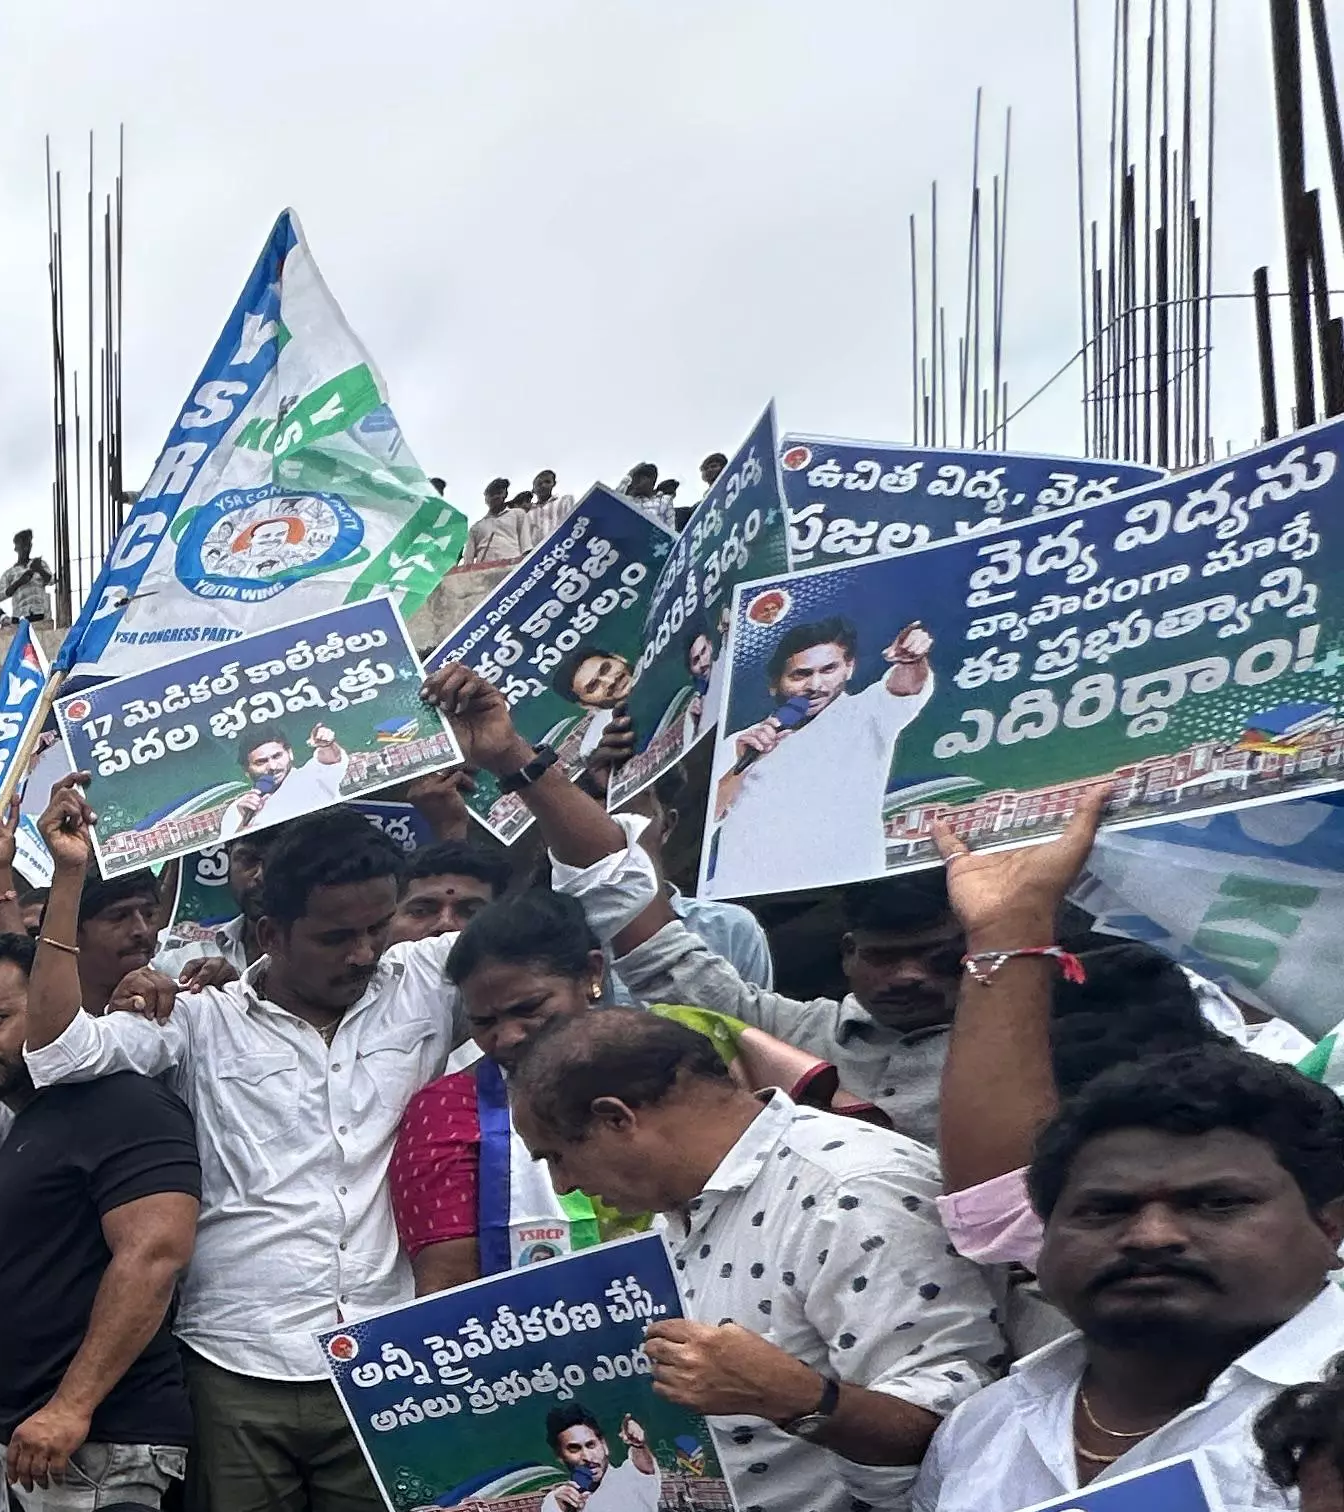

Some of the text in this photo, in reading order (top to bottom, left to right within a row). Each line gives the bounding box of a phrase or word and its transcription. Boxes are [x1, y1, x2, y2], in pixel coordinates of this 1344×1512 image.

[808, 459, 923, 493] ఉచిత
[966, 443, 1338, 609] వైద్య విద్యను
[519, 536, 619, 640] కాలేజీ
[528, 562, 648, 675] సంకల్పం
[953, 565, 1321, 692] ఈ ప్రభుత్వాన్ని
[966, 511, 1323, 645] వ్యాపారంగా మార్చే
[83, 629, 390, 741] 17 మెడికల్ కాలేజీలు
[115, 626, 244, 645] YSR CONGRESS PARTY
[90, 658, 396, 778] పేదల భవిష్యత్తు
[932, 625, 1324, 760] ఎదిరిద్దాం!
[518, 1226, 565, 1242] YSRCP
[369, 1393, 462, 1434] అసలు
[464, 1360, 586, 1416] ప్రభుత్వం
[424, 1302, 602, 1387] ప్రైవేటీకరణ
